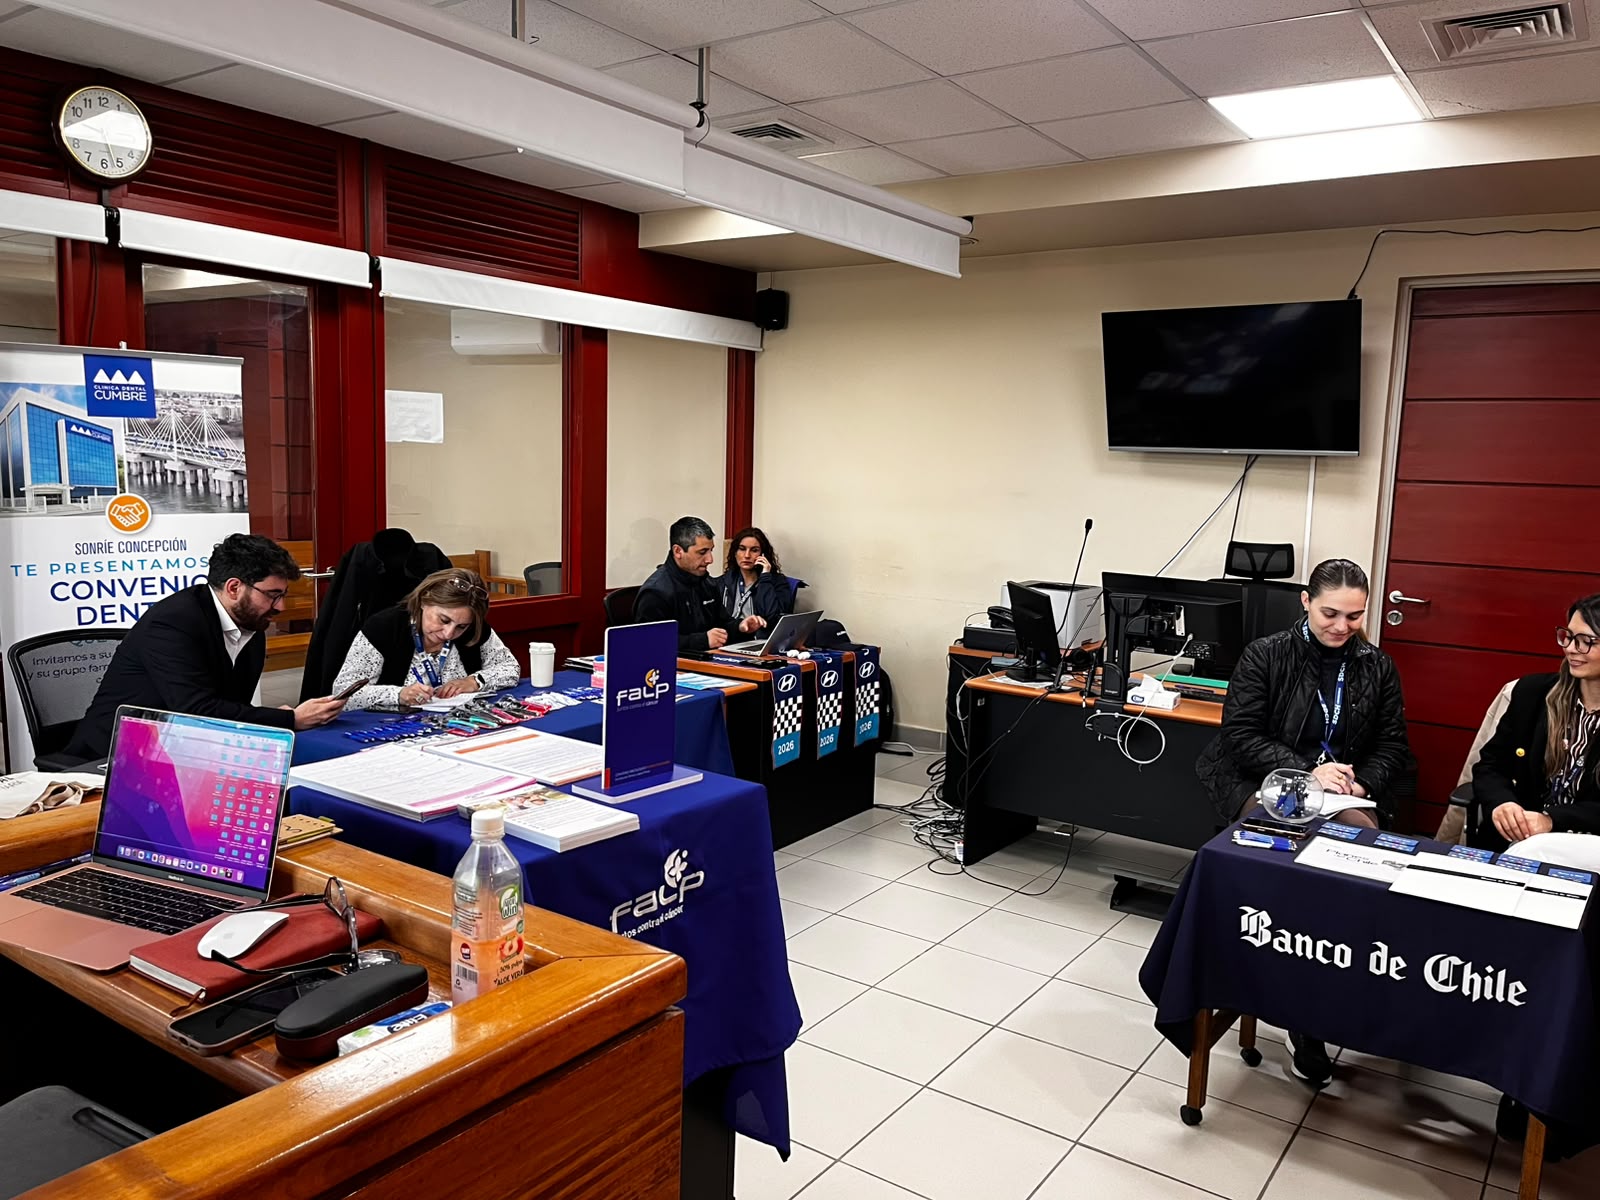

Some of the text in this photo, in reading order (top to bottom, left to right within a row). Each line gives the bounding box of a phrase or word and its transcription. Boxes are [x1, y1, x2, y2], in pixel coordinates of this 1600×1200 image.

[83, 97, 92, 109] 11
[97, 96, 110, 109] 12
[71, 106, 83, 118] 10
[72, 138, 80, 149] 8
[84, 151, 92, 162] 7
[127, 150, 135, 159] 4
[100, 158, 109, 169] 6
[116, 157, 124, 168] 5
[94, 390, 147, 402] CUMBRE
[75, 537, 187, 555] SONRÍE CONCEPCIÓN
[10, 556, 209, 577] TE PRESENTAMOS
[33, 654, 88, 666] Invitamos
[37, 670, 50, 678] su
[53, 666, 86, 679] grupo
[1332, 704, 1341, 725] SDCH
[820, 734, 834, 748] 2026
[778, 740, 794, 755] 2026
[1238, 906, 1528, 1007] Banco de Chile
